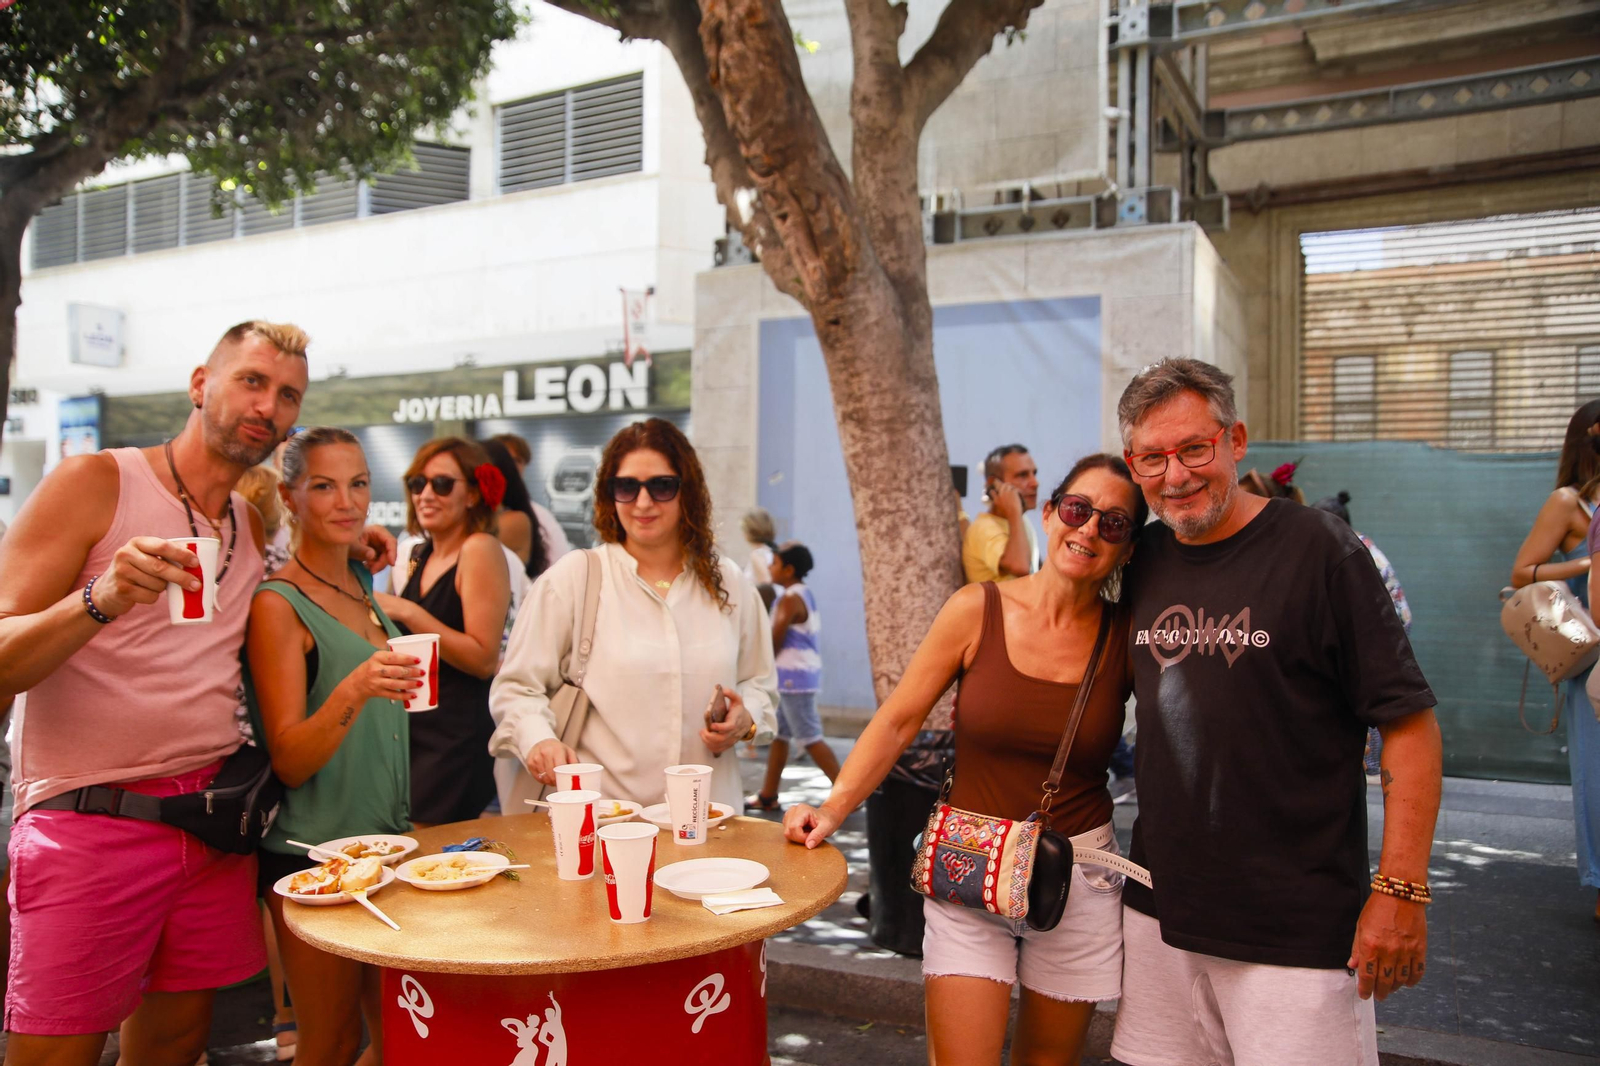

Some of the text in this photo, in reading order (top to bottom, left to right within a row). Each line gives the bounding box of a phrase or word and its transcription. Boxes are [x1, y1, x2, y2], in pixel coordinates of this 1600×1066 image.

[393, 360, 648, 423] JOYERIA LEON
[1366, 962, 1425, 977] EVER
